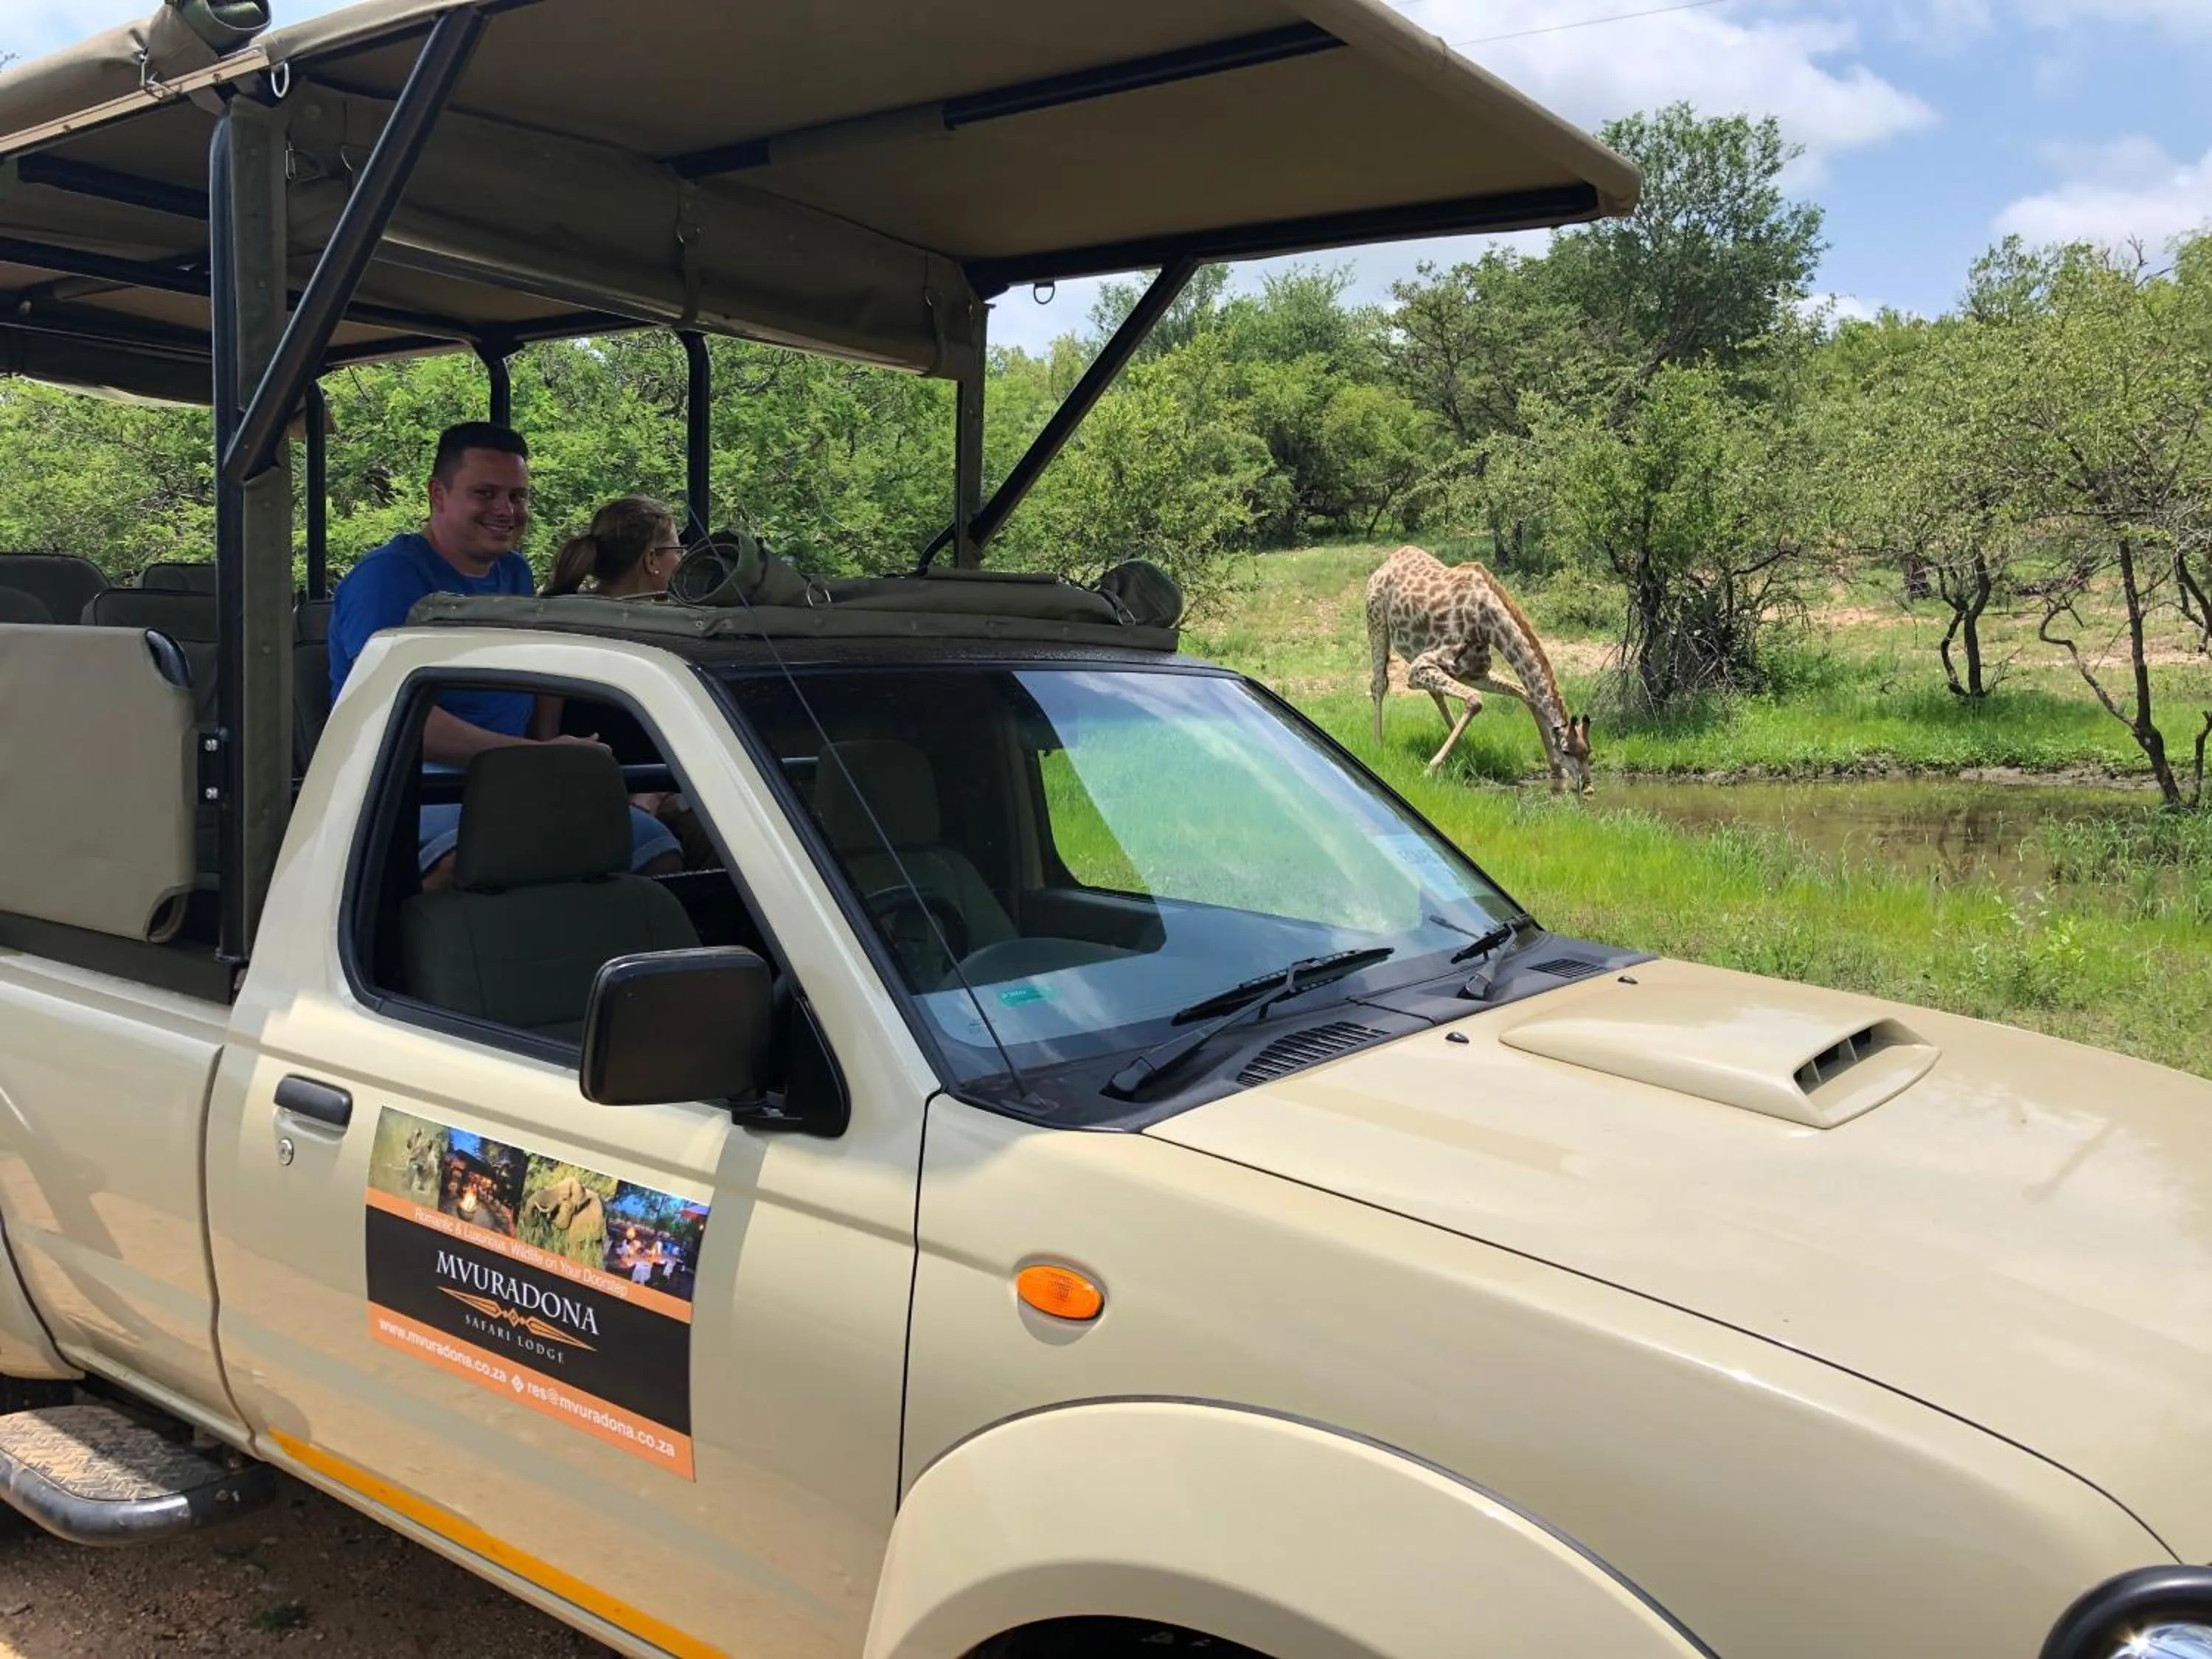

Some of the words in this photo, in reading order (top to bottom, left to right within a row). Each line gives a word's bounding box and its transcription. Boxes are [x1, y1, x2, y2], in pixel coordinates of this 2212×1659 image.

[437, 1250, 600, 1336] MVURADONA
[545, 1259, 557, 1270] on
[560, 1259, 581, 1279] Your
[583, 1267, 627, 1298] Doorstep
[465, 1315, 510, 1341] SAFARI
[518, 1335, 565, 1364] LODGE
[378, 1318, 507, 1382] www.mvuradona.co.za
[526, 1382, 675, 1458] res@mvuradona.co.za
